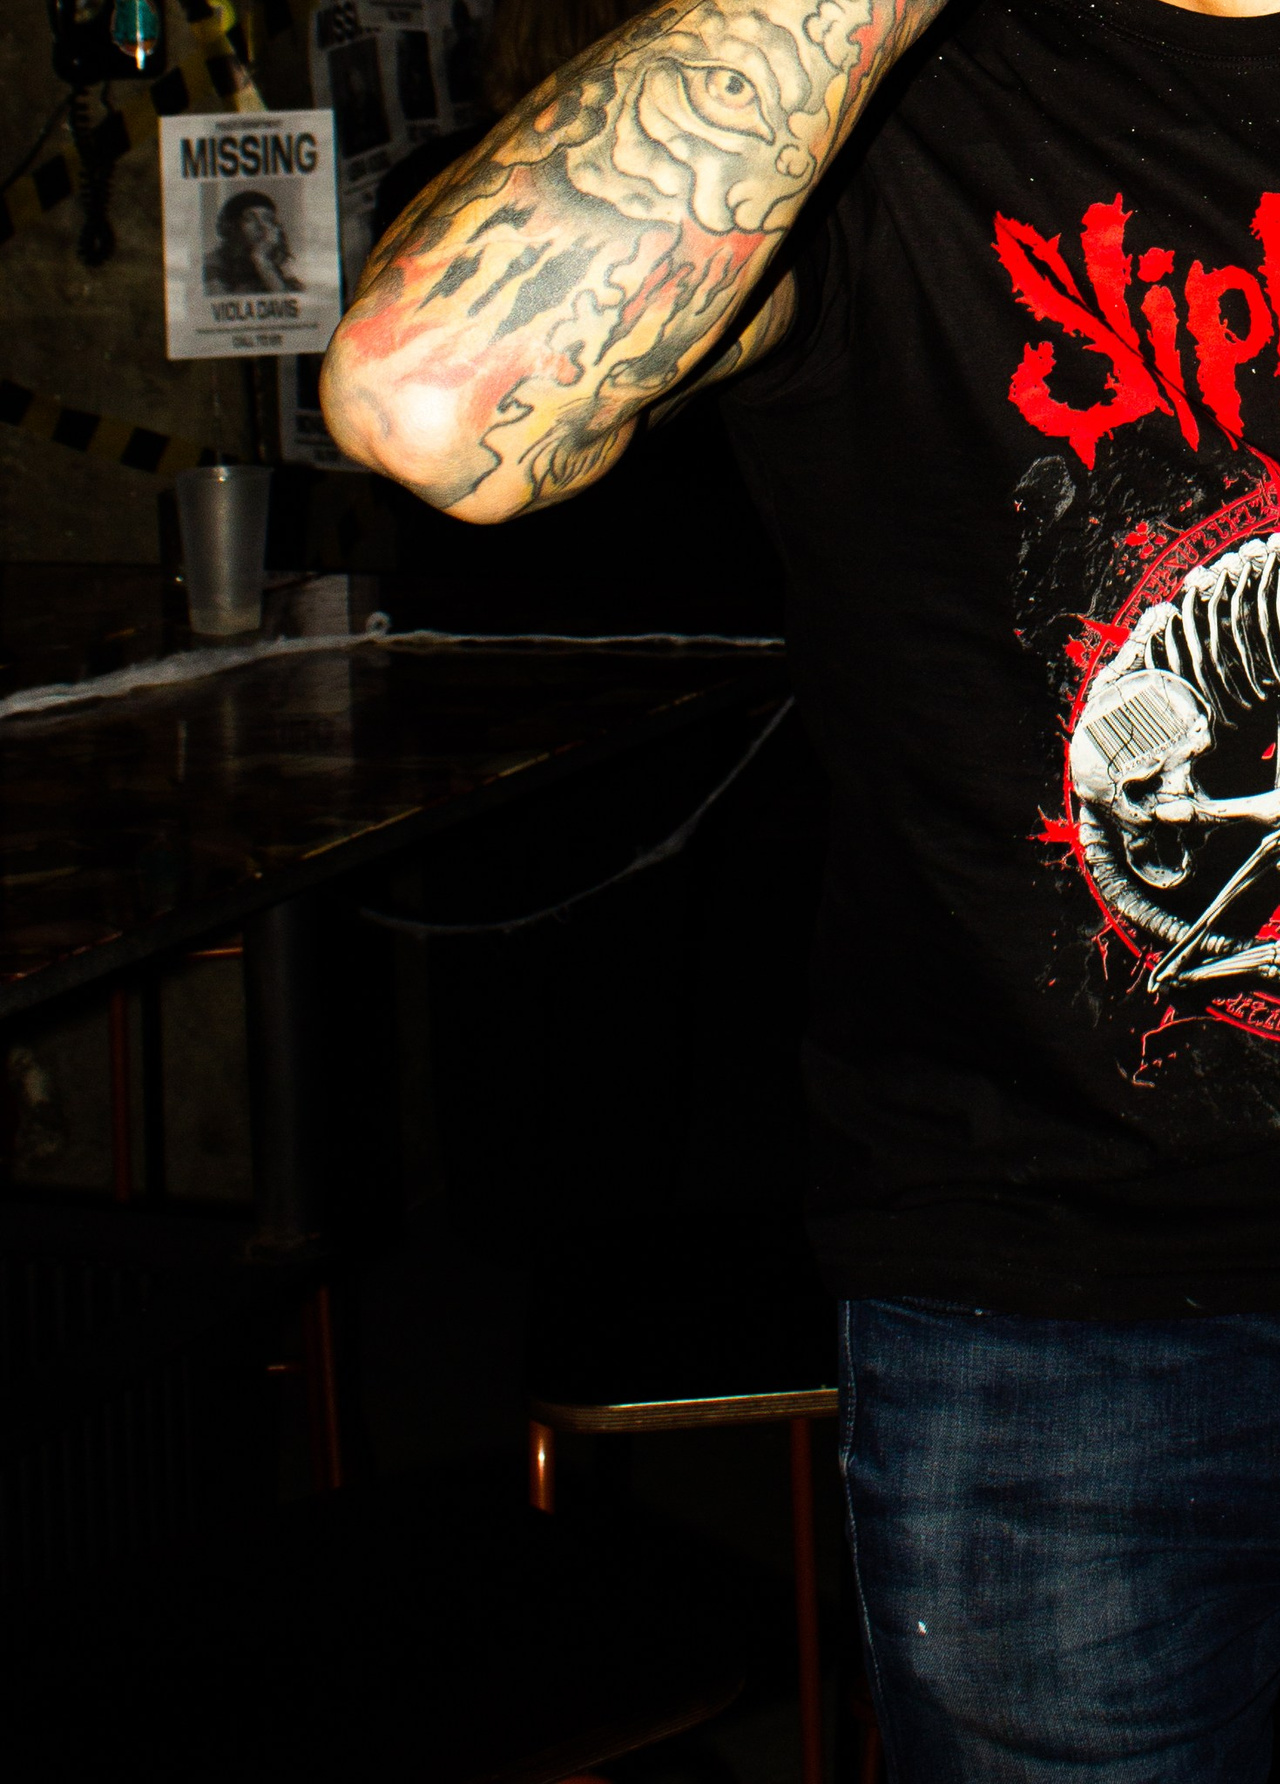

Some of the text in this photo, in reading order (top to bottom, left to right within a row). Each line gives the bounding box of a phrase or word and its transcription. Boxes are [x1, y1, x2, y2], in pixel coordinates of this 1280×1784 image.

[180, 132, 318, 179] MISSING
[211, 299, 299, 322] VIOLA DAVIS
